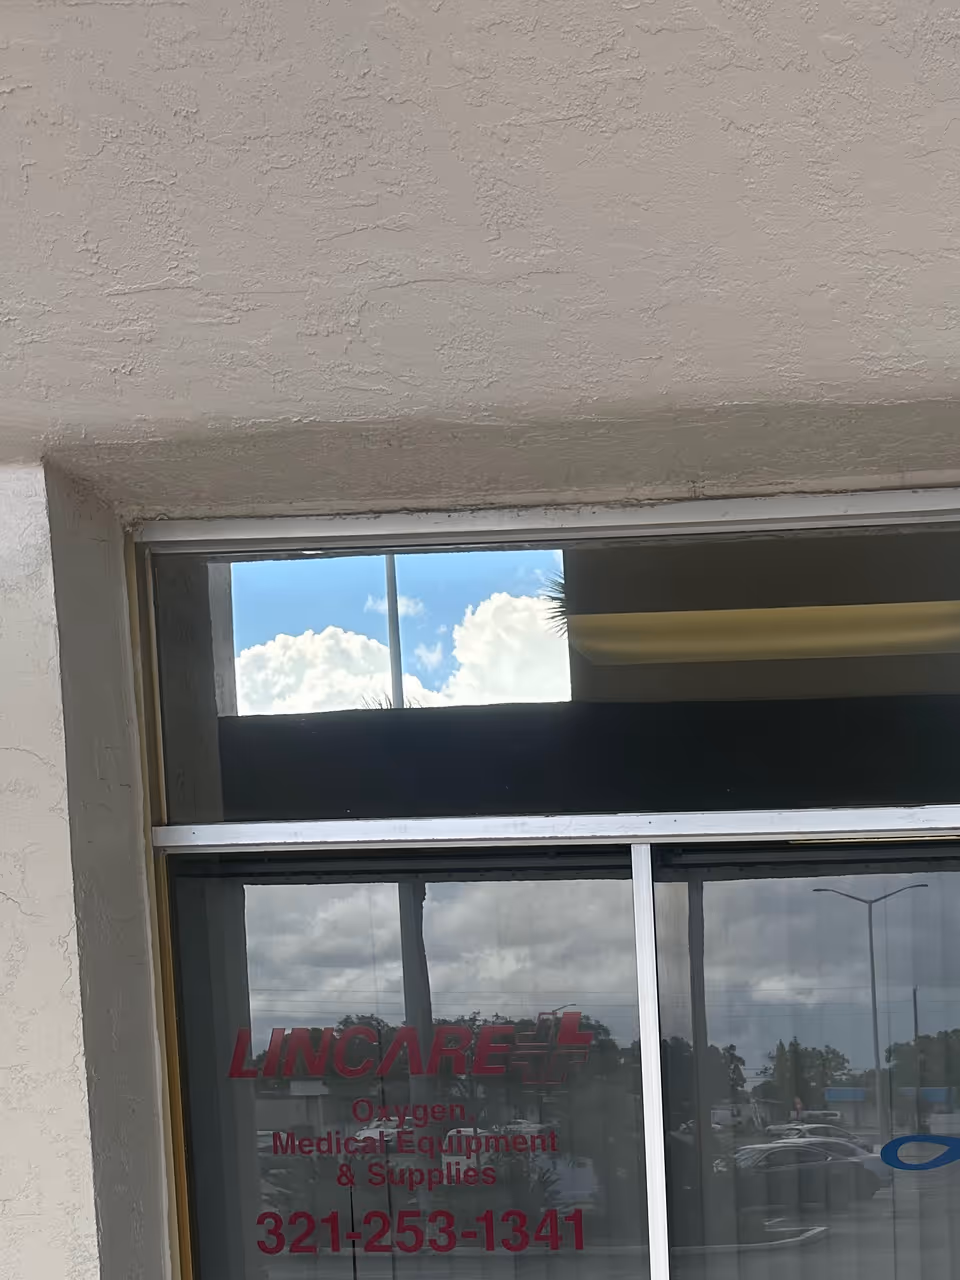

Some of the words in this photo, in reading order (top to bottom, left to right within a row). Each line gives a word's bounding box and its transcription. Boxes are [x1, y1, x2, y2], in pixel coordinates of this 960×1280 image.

[229, 1026, 514, 1078] LINCARE
[351, 1098, 476, 1128] Oxygen,
[272, 1131, 386, 1155] Medical
[397, 1129, 558, 1160] Equipment
[336, 1163, 355, 1187] &
[367, 1161, 498, 1191] Supplies
[255, 1208, 584, 1256] 321-253-1341
